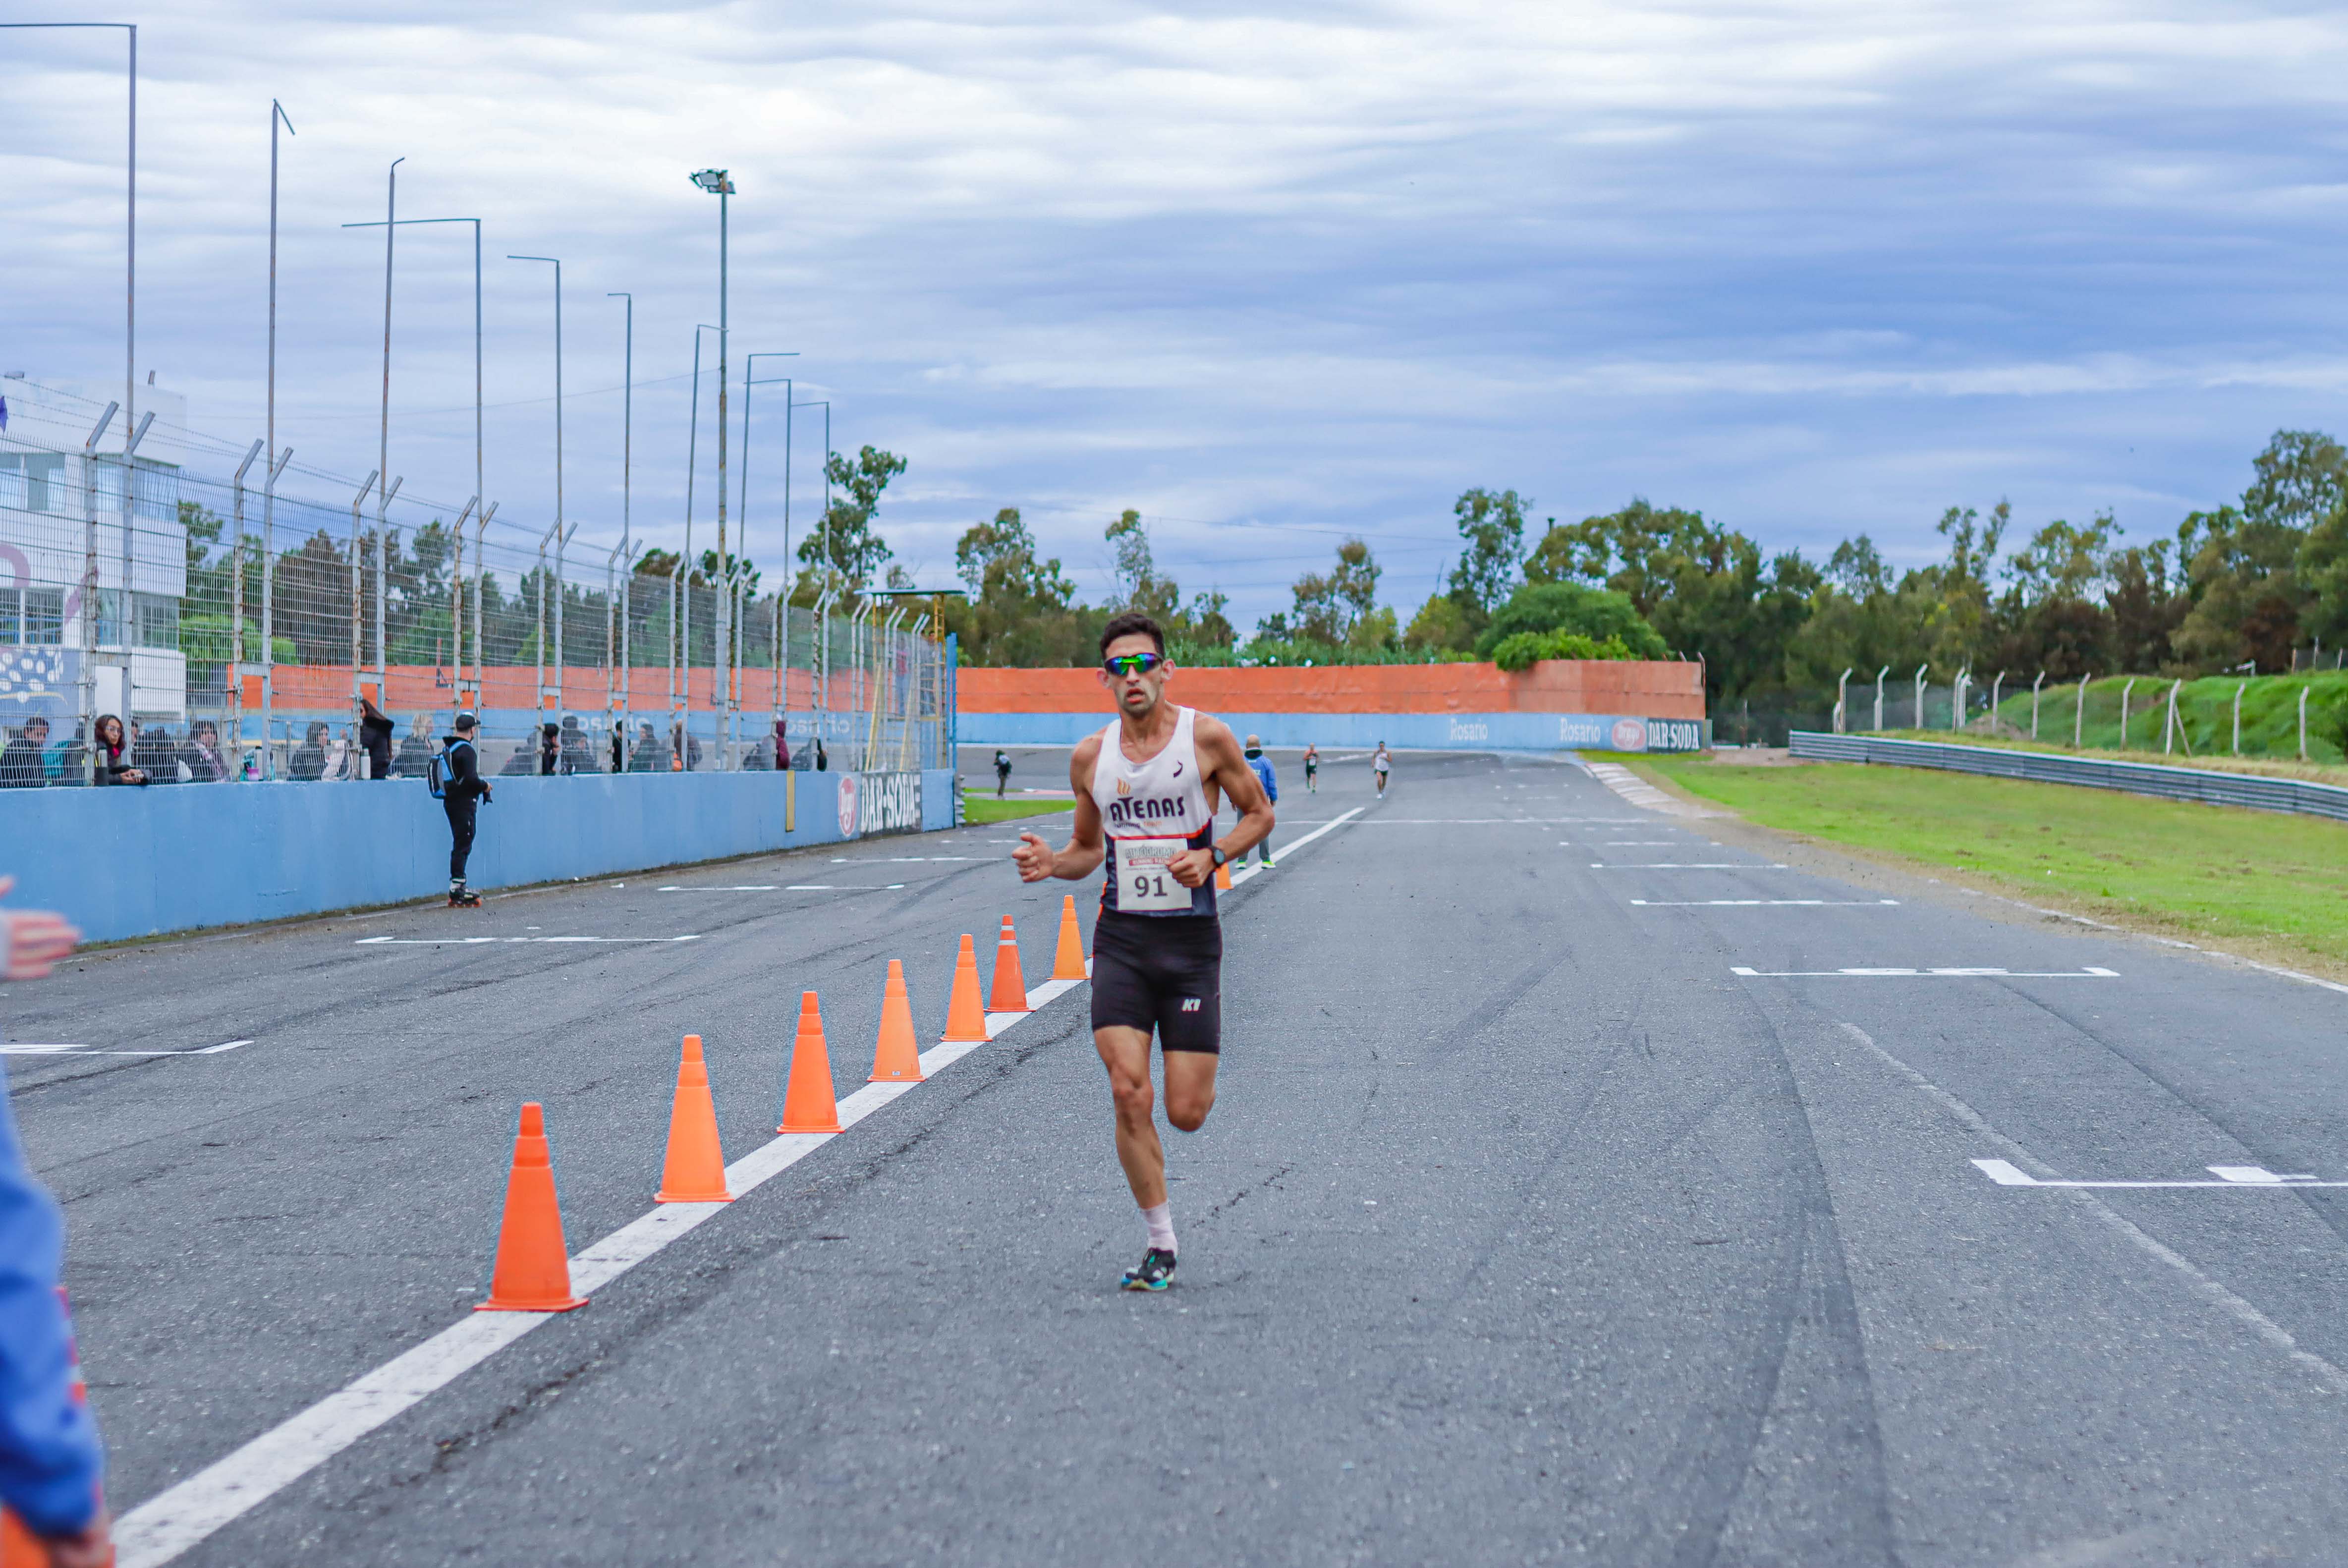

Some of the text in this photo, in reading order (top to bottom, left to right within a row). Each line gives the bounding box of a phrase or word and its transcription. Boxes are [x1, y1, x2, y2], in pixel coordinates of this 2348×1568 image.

[561, 711, 650, 732] osio
[776, 713, 850, 734] osaio
[1450, 718, 1488, 741] Rosario
[1561, 717, 1601, 742] Rosario
[1110, 796, 1184, 821] ATENAS
[1135, 876, 1168, 897] 91
